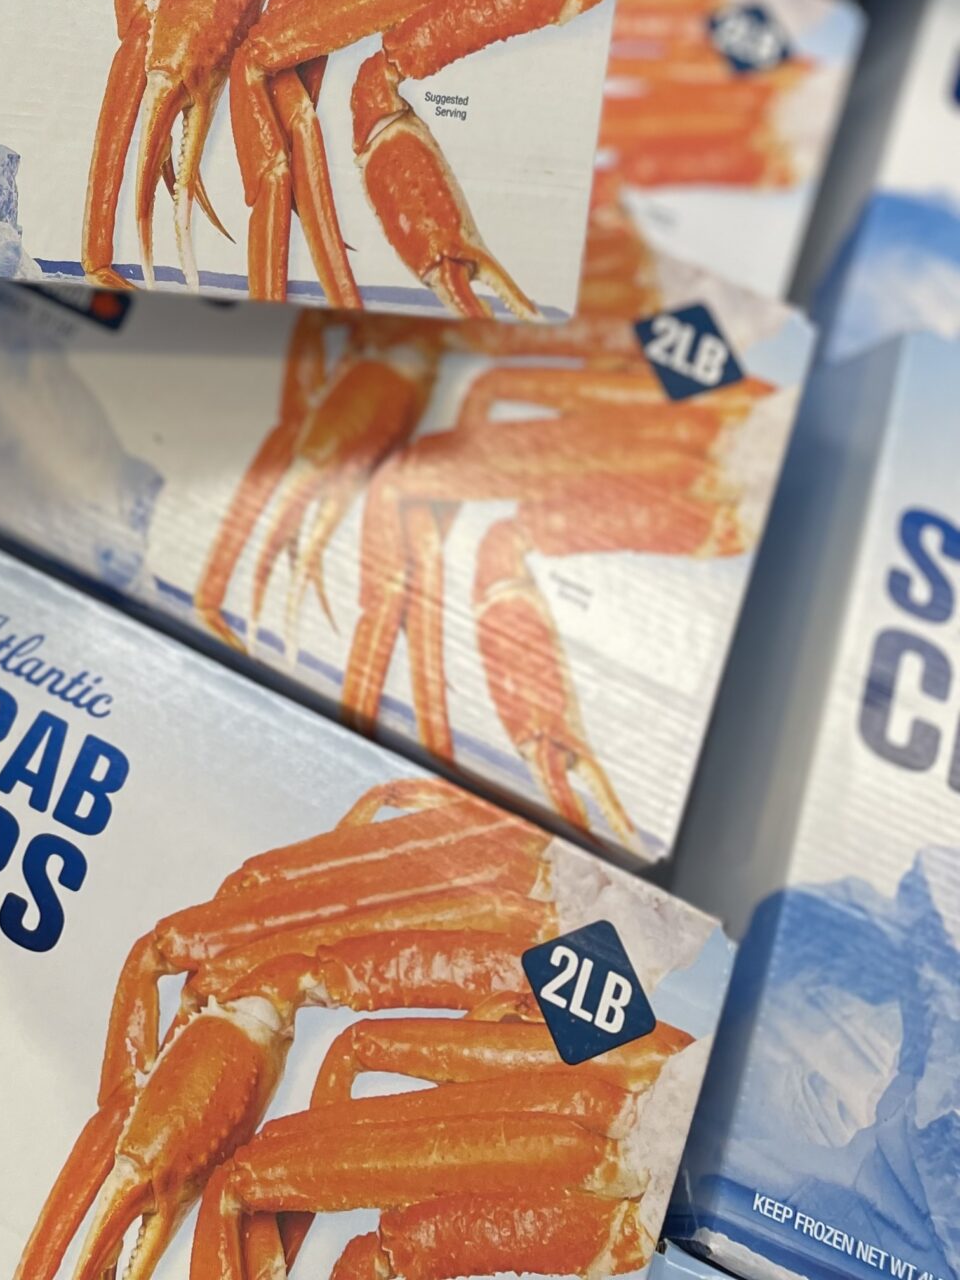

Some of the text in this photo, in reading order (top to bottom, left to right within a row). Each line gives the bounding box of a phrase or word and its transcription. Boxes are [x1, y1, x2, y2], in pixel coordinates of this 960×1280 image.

[424, 91, 469, 106] Suggested
[435, 106, 467, 121] Serving
[642, 318, 729, 389] 2LB
[540, 945, 632, 1035] 2LB
[753, 1193, 917, 1280] KEEP FROZEN NET WT
